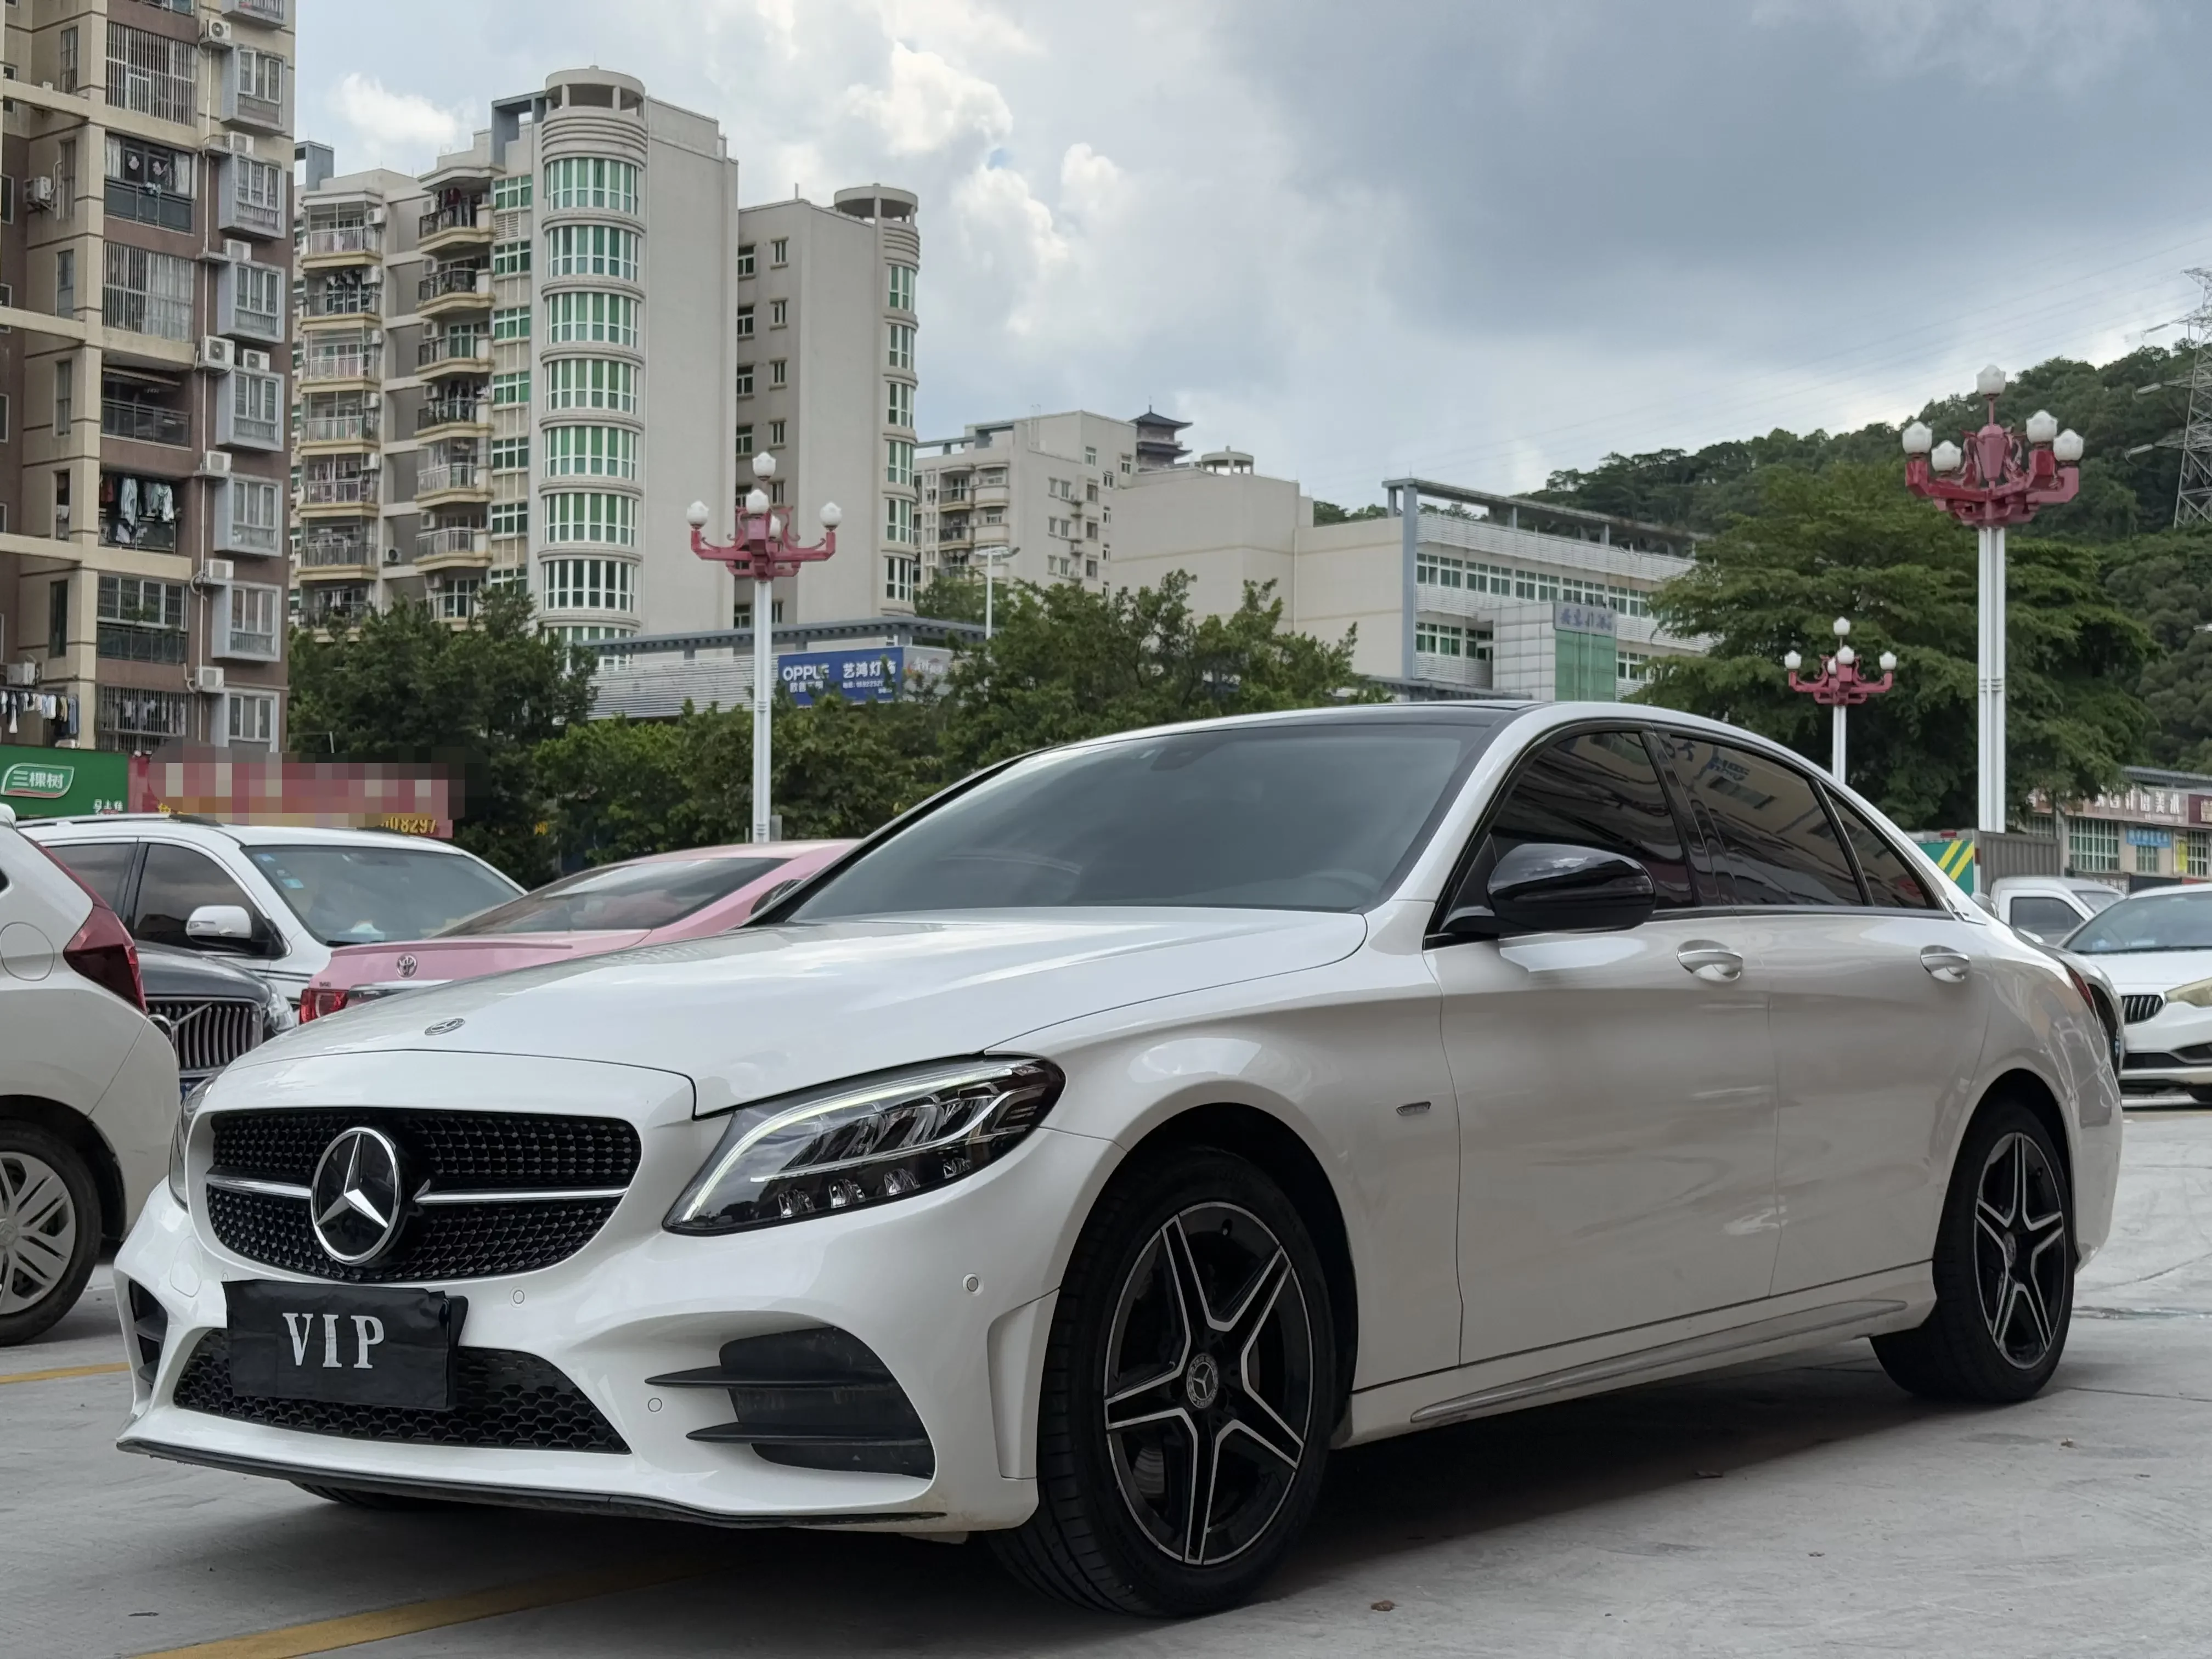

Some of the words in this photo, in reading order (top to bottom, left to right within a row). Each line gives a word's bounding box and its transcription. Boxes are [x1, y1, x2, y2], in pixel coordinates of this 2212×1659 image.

[11, 770, 64, 789] 三棵树
[282, 1312, 386, 1369] VIP
